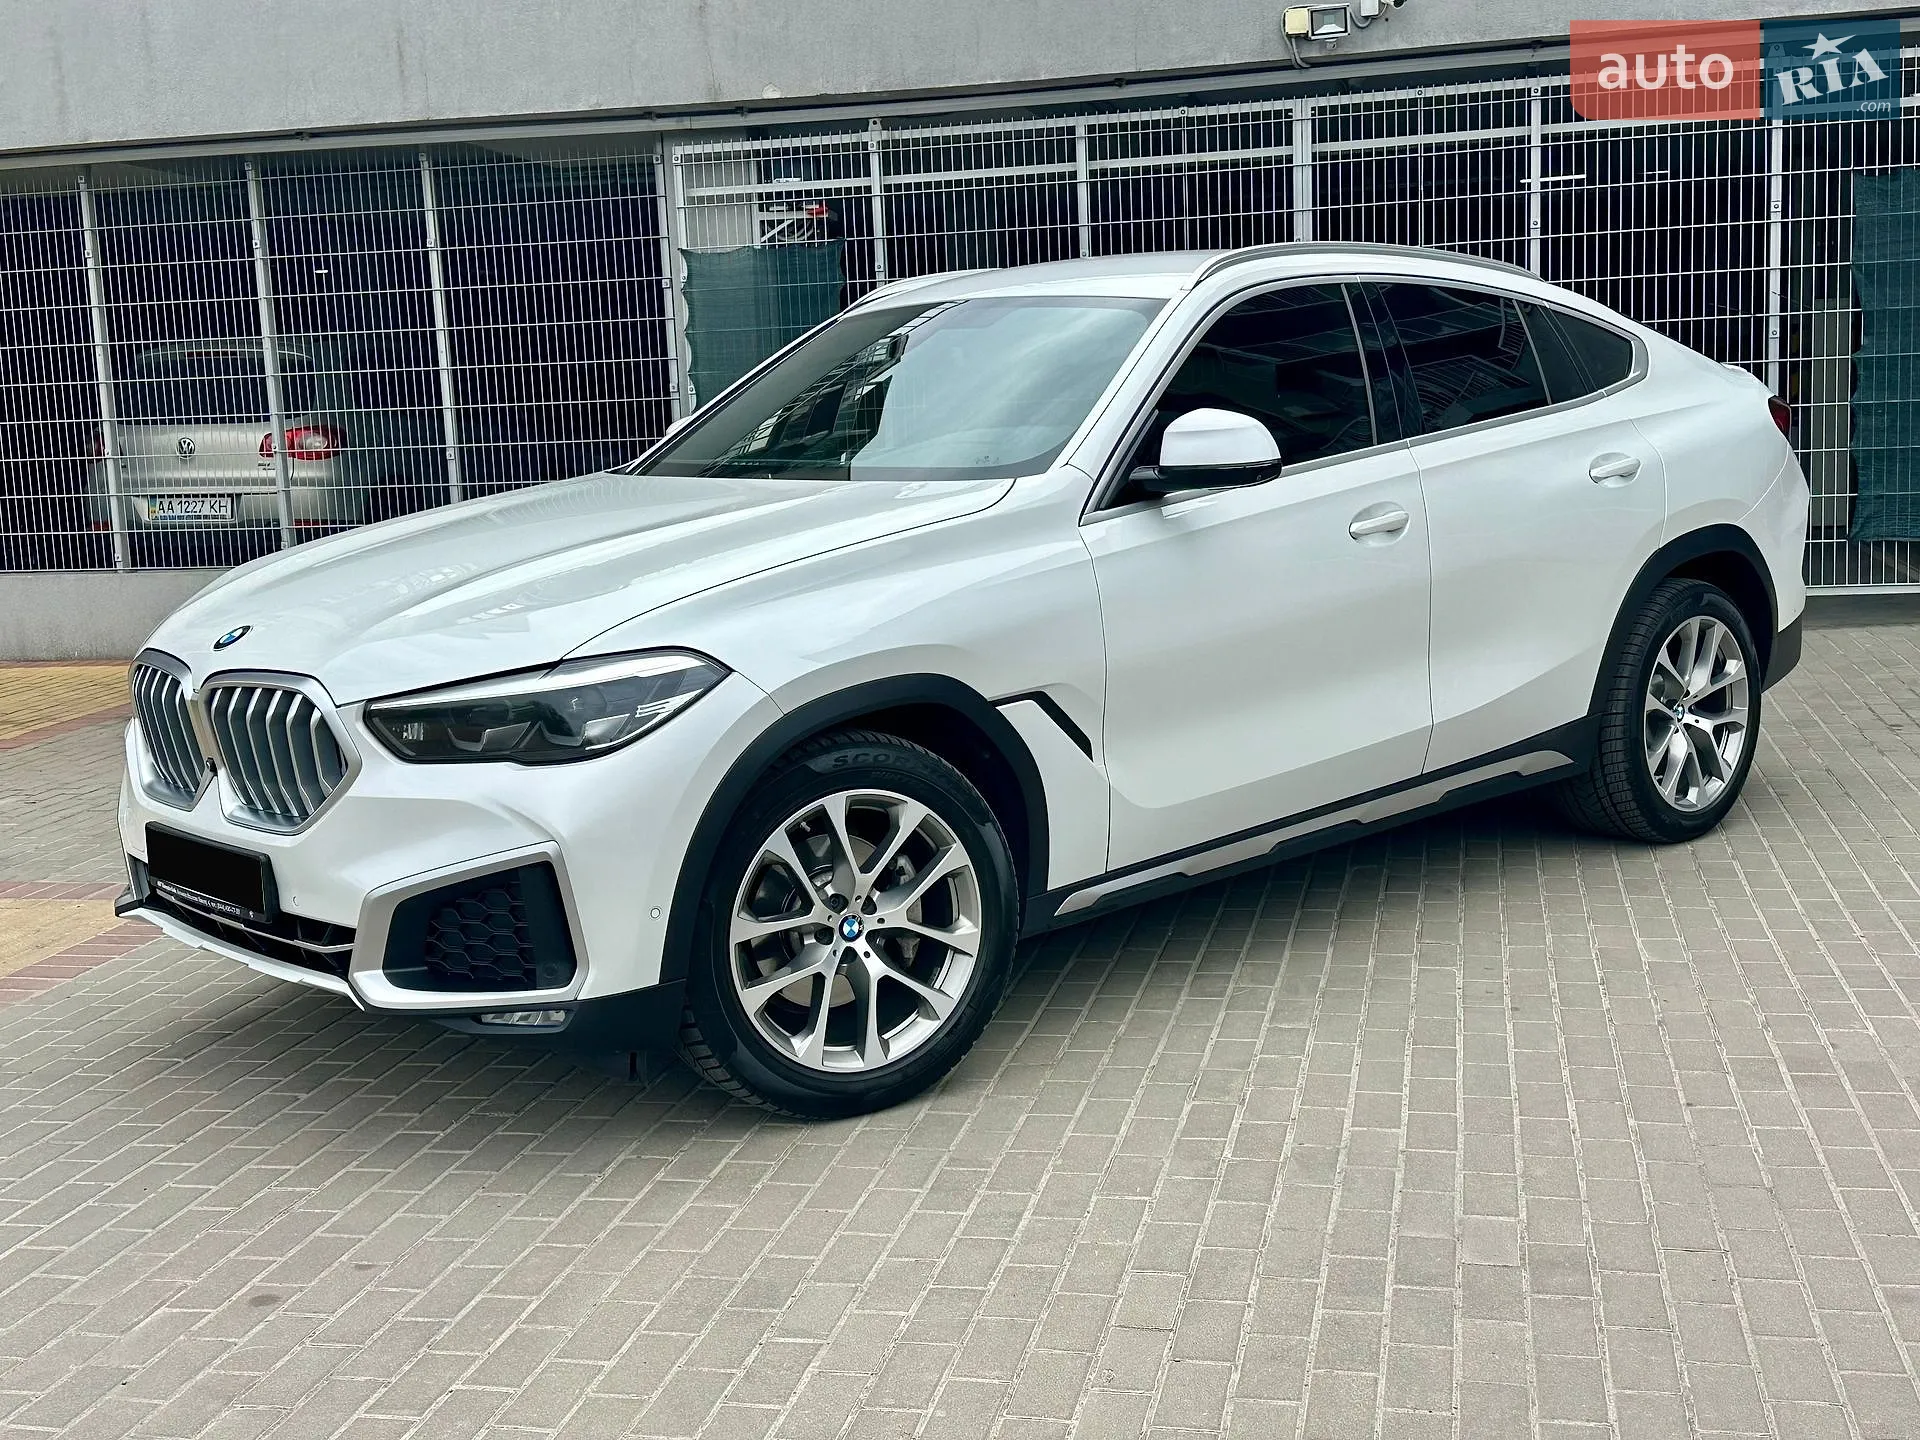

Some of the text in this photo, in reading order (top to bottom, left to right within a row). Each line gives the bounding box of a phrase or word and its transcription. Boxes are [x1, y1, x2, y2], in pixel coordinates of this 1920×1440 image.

[158, 499, 229, 514] AA 1227 KH
